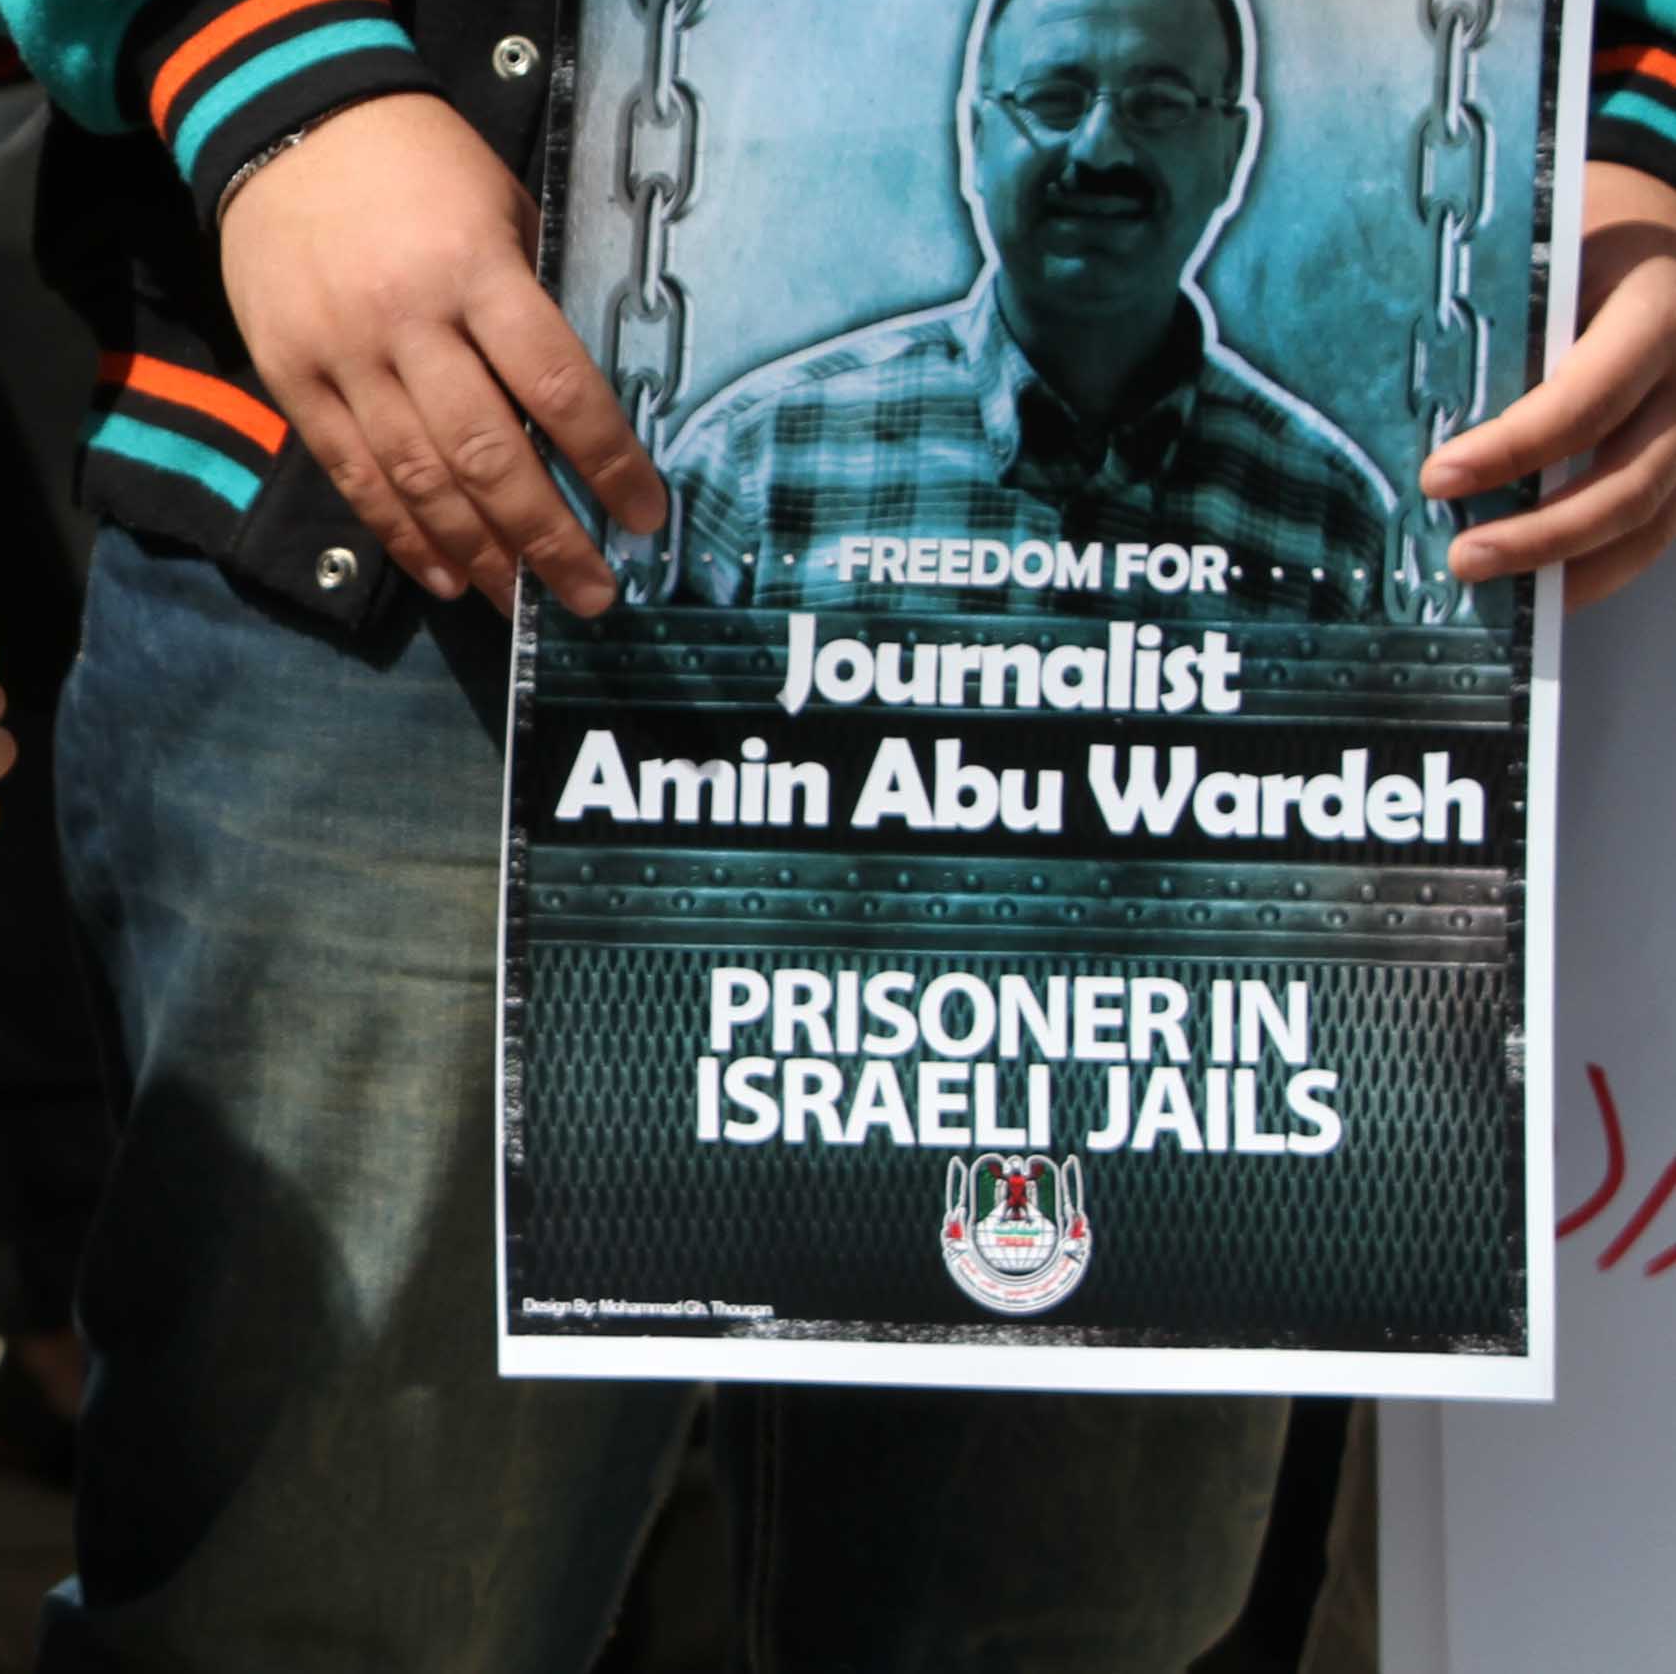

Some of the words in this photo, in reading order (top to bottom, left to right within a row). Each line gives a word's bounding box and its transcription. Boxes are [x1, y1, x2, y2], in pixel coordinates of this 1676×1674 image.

[838, 537, 1102, 589] FREEDOM
[1114, 544, 1227, 594] FOR
[777, 613, 1242, 715] Journalist
[553, 729, 829, 827] Amin
[850, 738, 1062, 833] Abu
[1086, 745, 1484, 844] Wardeh
[710, 965, 1190, 1061] PRISONER
[1211, 981, 1308, 1064] IN
[697, 1056, 1050, 1148] ISRAELI
[1086, 1070, 1341, 1157] JAILS
[522, 1297, 571, 1319] Design
